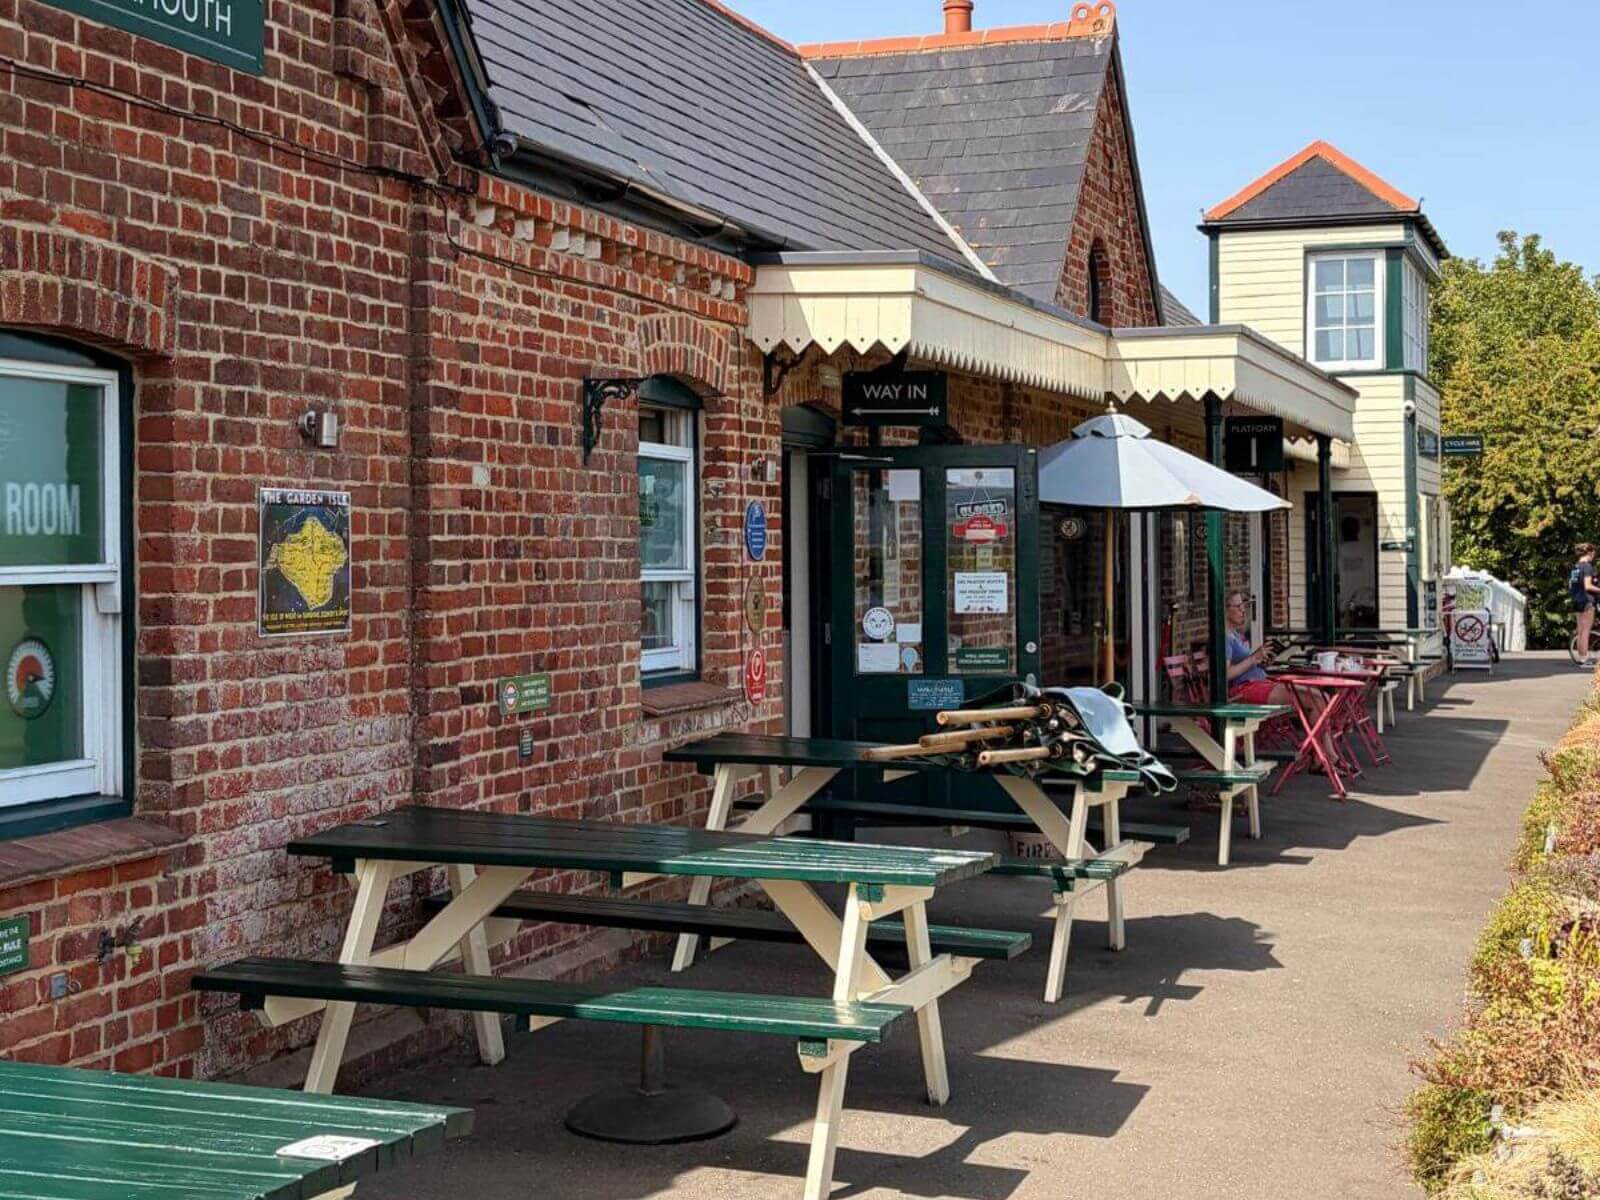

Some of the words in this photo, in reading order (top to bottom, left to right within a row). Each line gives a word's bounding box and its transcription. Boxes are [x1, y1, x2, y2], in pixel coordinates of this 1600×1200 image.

[134, 0, 232, 37] OUTH
[862, 384, 902, 400] WAY
[908, 384, 927, 400] IN
[1231, 424, 1277, 433] PLATFORM
[264, 493, 282, 505] THE
[286, 493, 324, 505] GARDEN
[328, 495, 349, 506] ISLE
[6, 481, 81, 536] ROOM
